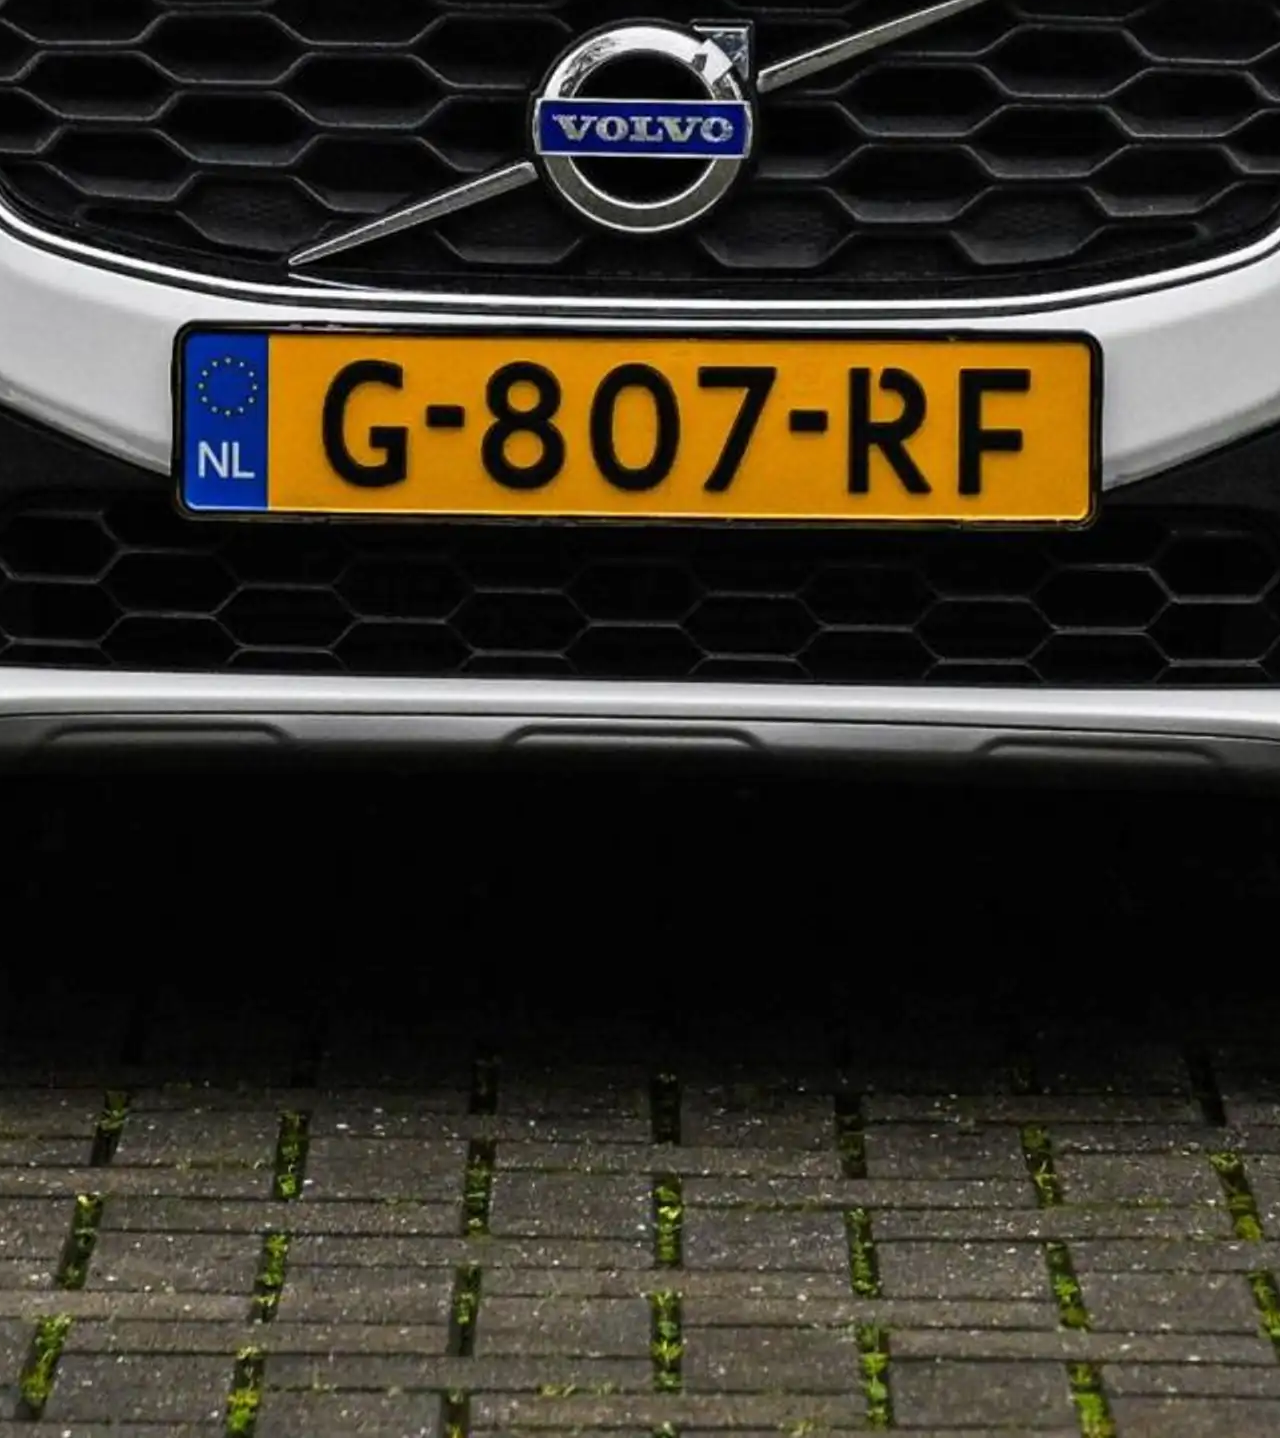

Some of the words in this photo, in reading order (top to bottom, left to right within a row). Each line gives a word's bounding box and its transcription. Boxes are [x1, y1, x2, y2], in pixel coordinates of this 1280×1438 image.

[552, 114, 734, 142] VOLVO
[322, 359, 1032, 497] G-807-RF
[197, 440, 256, 479] NL
